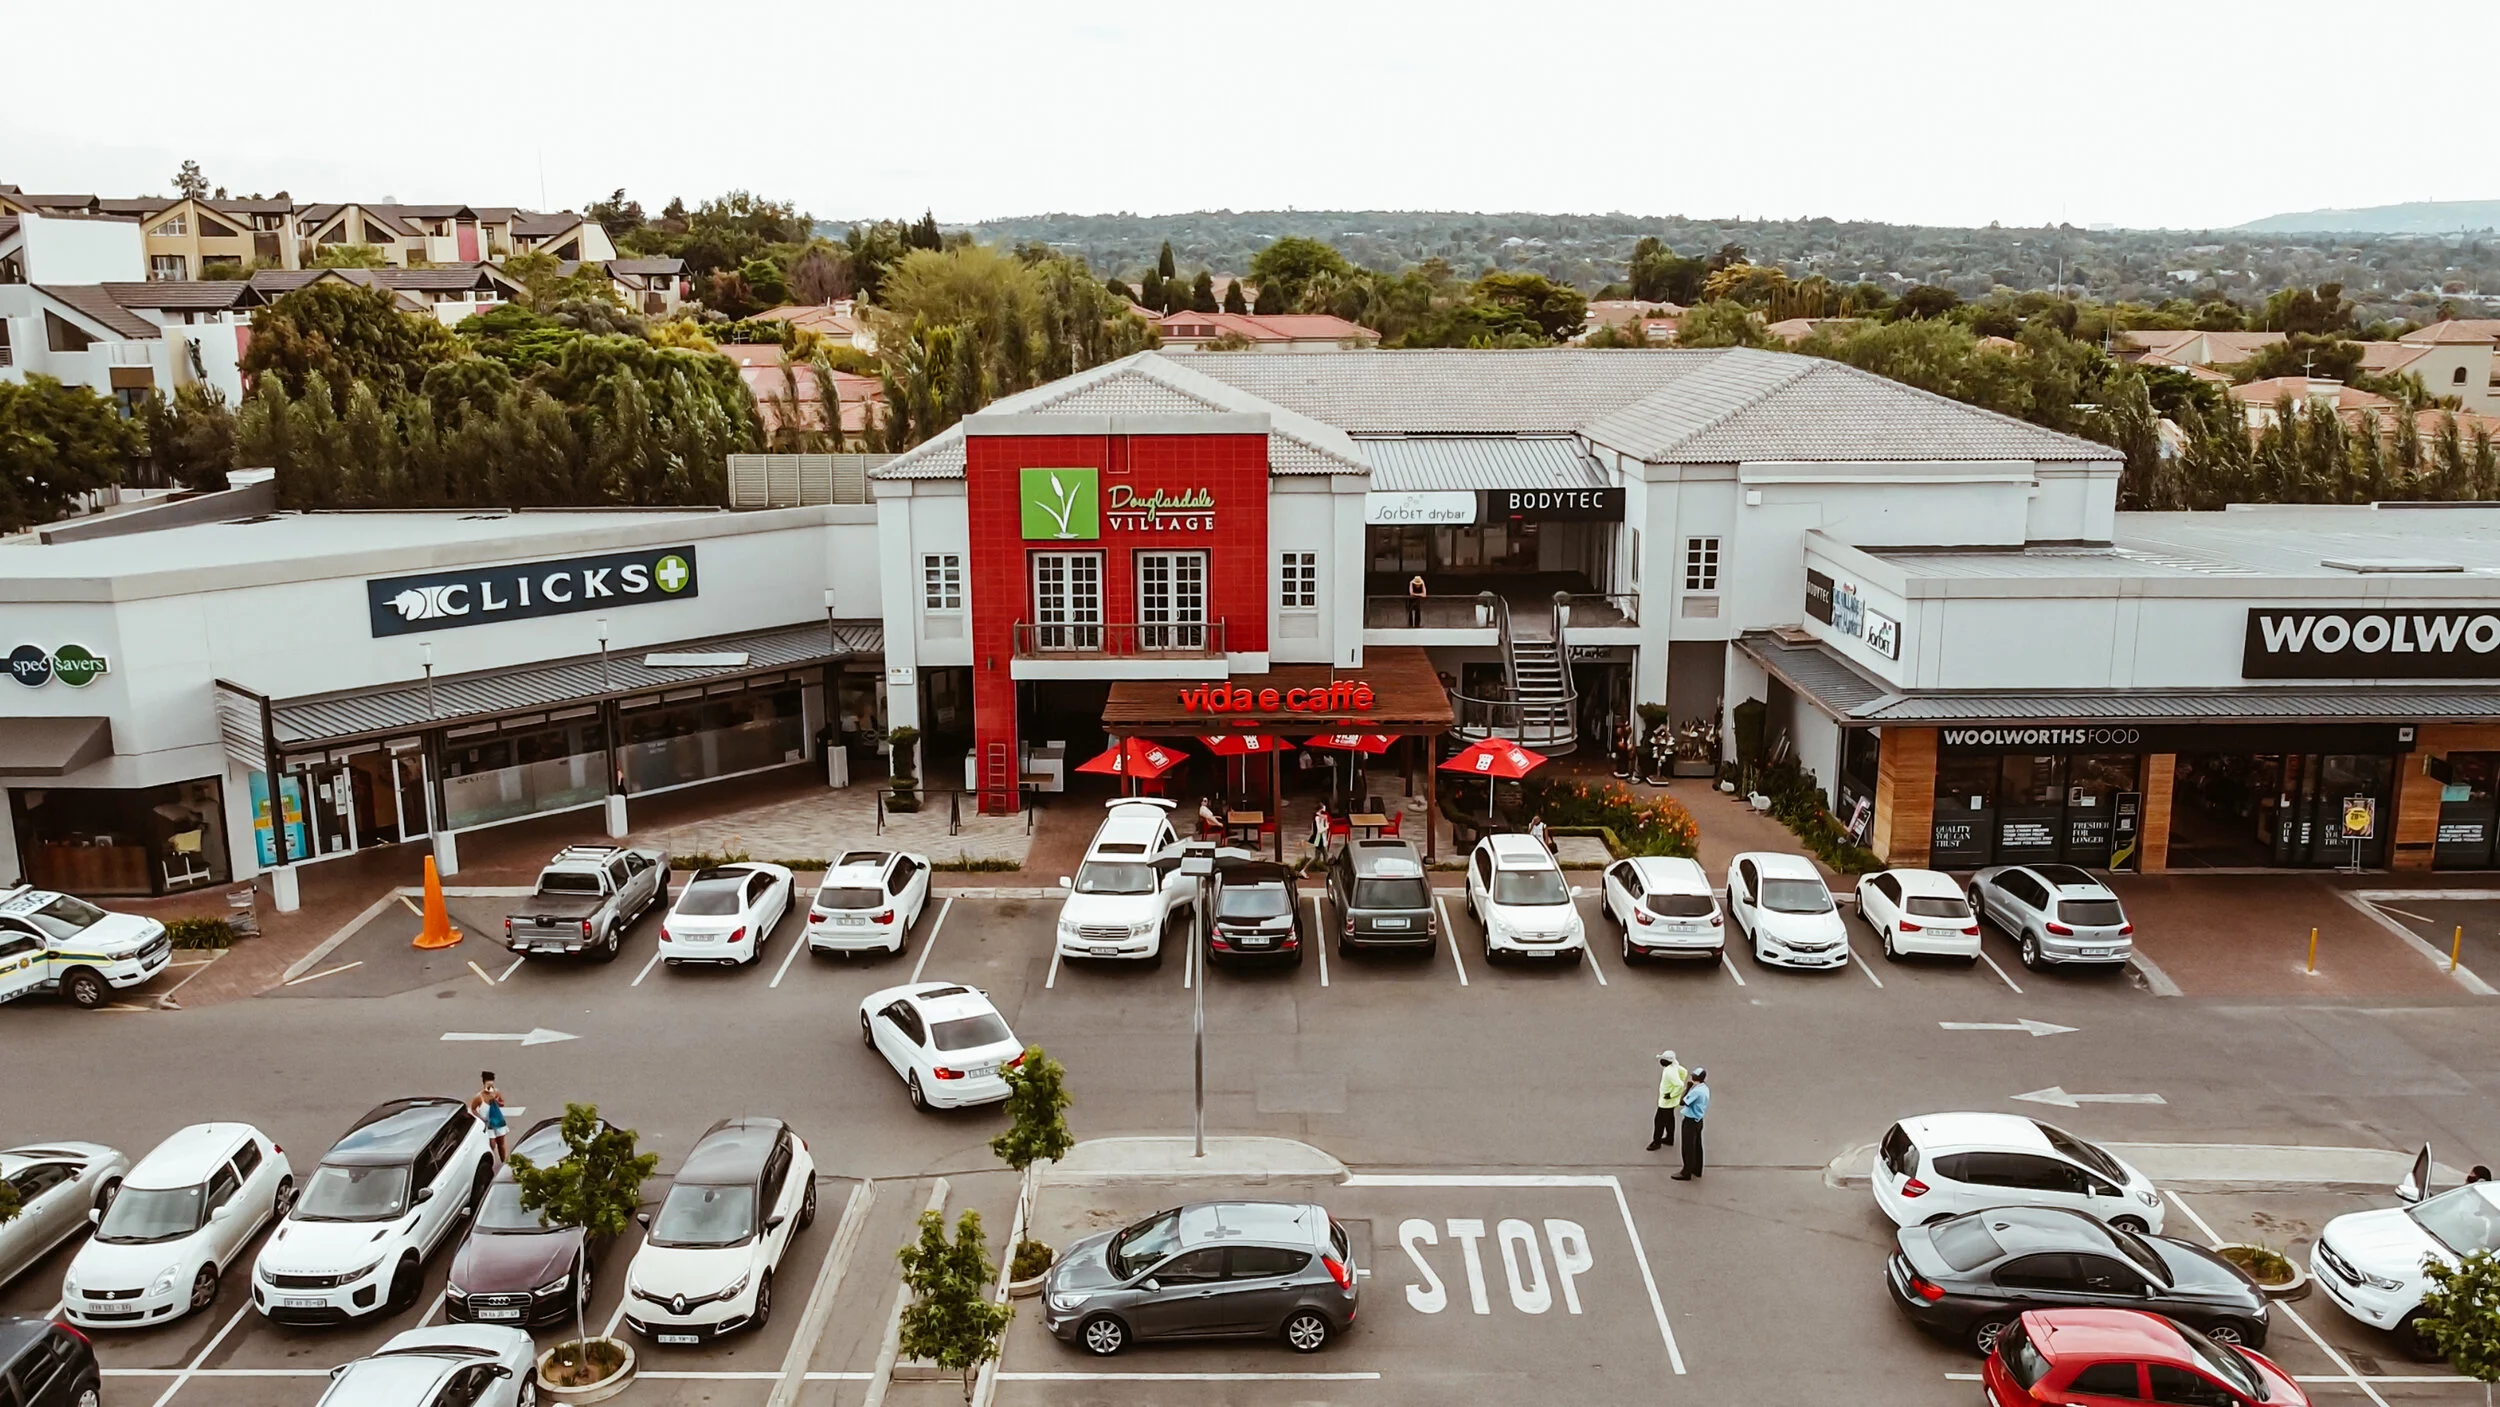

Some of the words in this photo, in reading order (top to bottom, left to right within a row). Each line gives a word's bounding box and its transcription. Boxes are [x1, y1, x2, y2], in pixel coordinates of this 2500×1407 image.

[1108, 485, 1215, 521] Douglasdale
[1509, 492, 1604, 509] BODYTEC
[1428, 509, 1465, 521] drybar
[1109, 517, 1214, 531] VILLAGE
[437, 564, 650, 616] CLICKS
[13, 658, 48, 676] spec
[55, 657, 104, 671] savers
[1180, 681, 1253, 713] vida
[1258, 688, 1280, 713] e
[1944, 729, 2086, 745] WOOLWORTHS
[2088, 728, 2140, 744] FOOD
[1936, 825, 1971, 834] QUALITY
[2073, 821, 2109, 829] FRESHER
[1936, 840, 1960, 848] TRUST
[2072, 836, 2104, 844] LONGER
[1398, 1219, 1594, 1315] STOP
